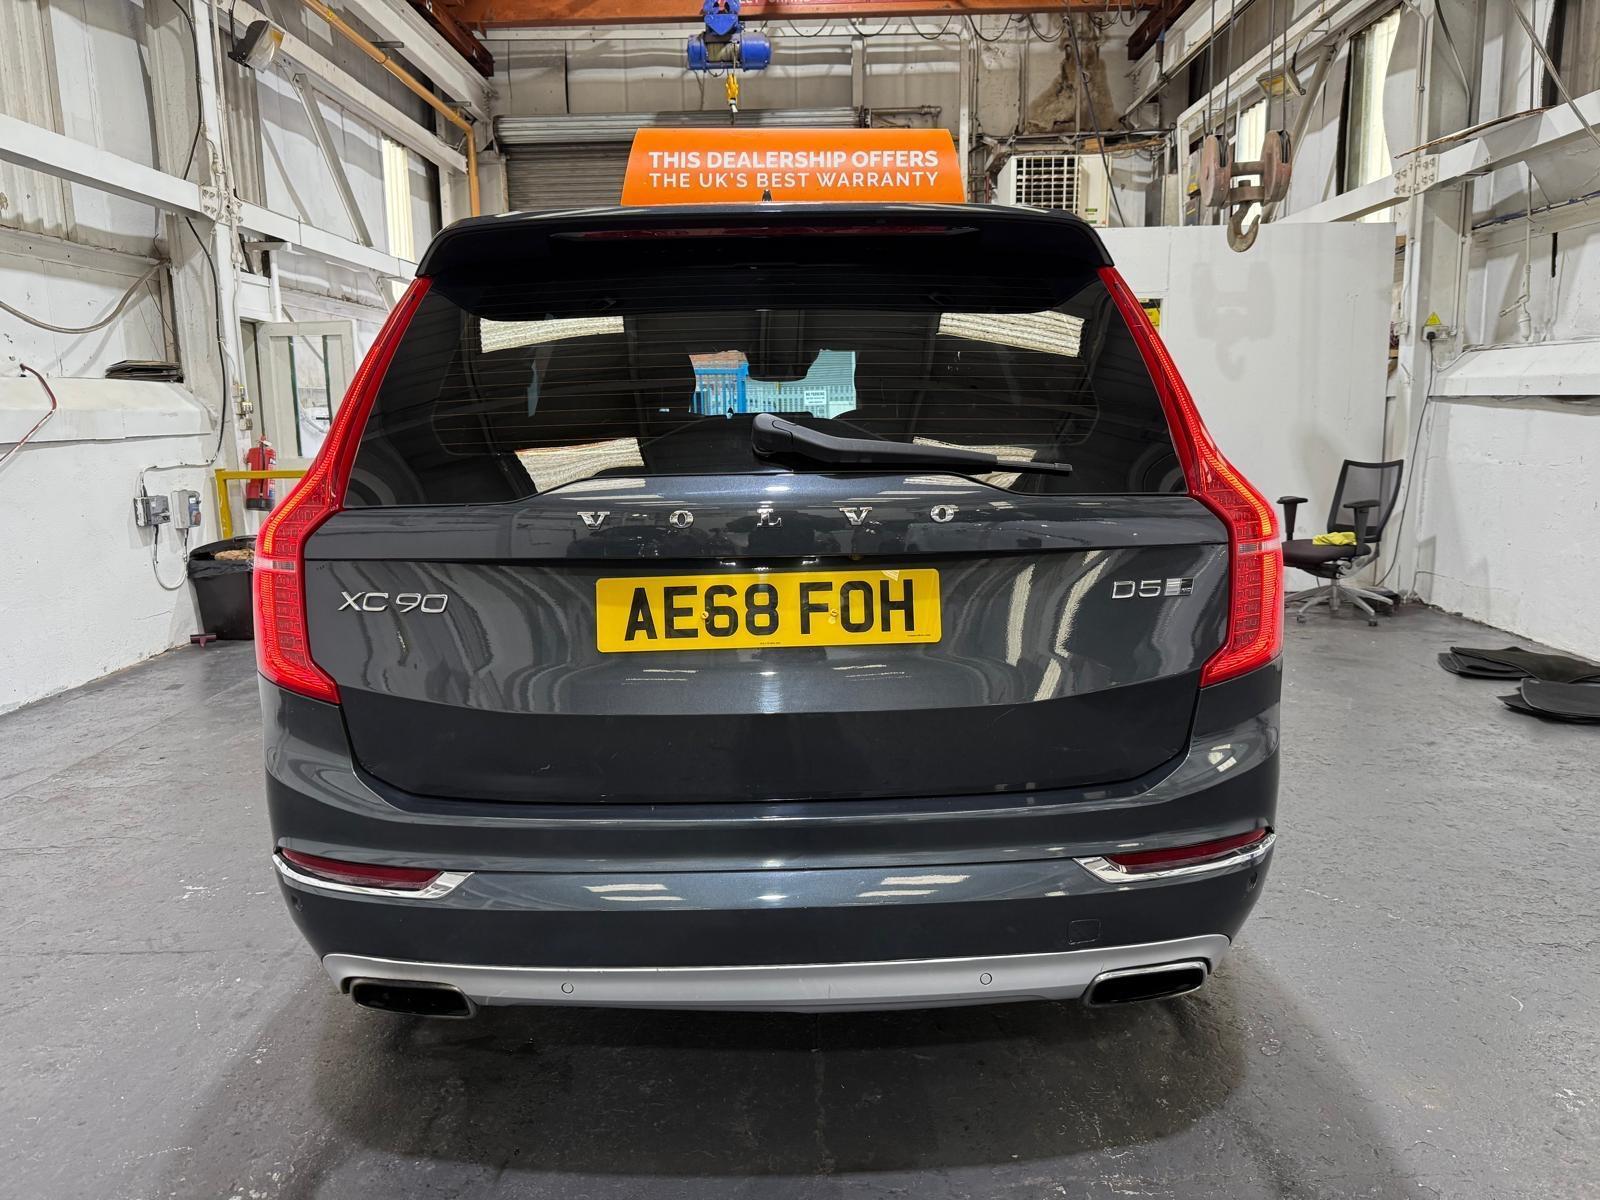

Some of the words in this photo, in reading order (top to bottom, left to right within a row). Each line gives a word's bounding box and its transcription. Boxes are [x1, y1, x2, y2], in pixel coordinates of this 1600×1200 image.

[648, 151, 701, 169] THIS
[707, 151, 847, 169] DEALERSHIP
[851, 150, 939, 168] OFFERS
[648, 173, 691, 188] THE
[699, 173, 748, 188] UK'S
[756, 172, 810, 188] BEST
[816, 171, 939, 188] WARRANTY
[576, 504, 959, 531] VOLVO
[1112, 579, 1162, 599] D5
[624, 583, 779, 642] AE68
[799, 578, 916, 636] FOH
